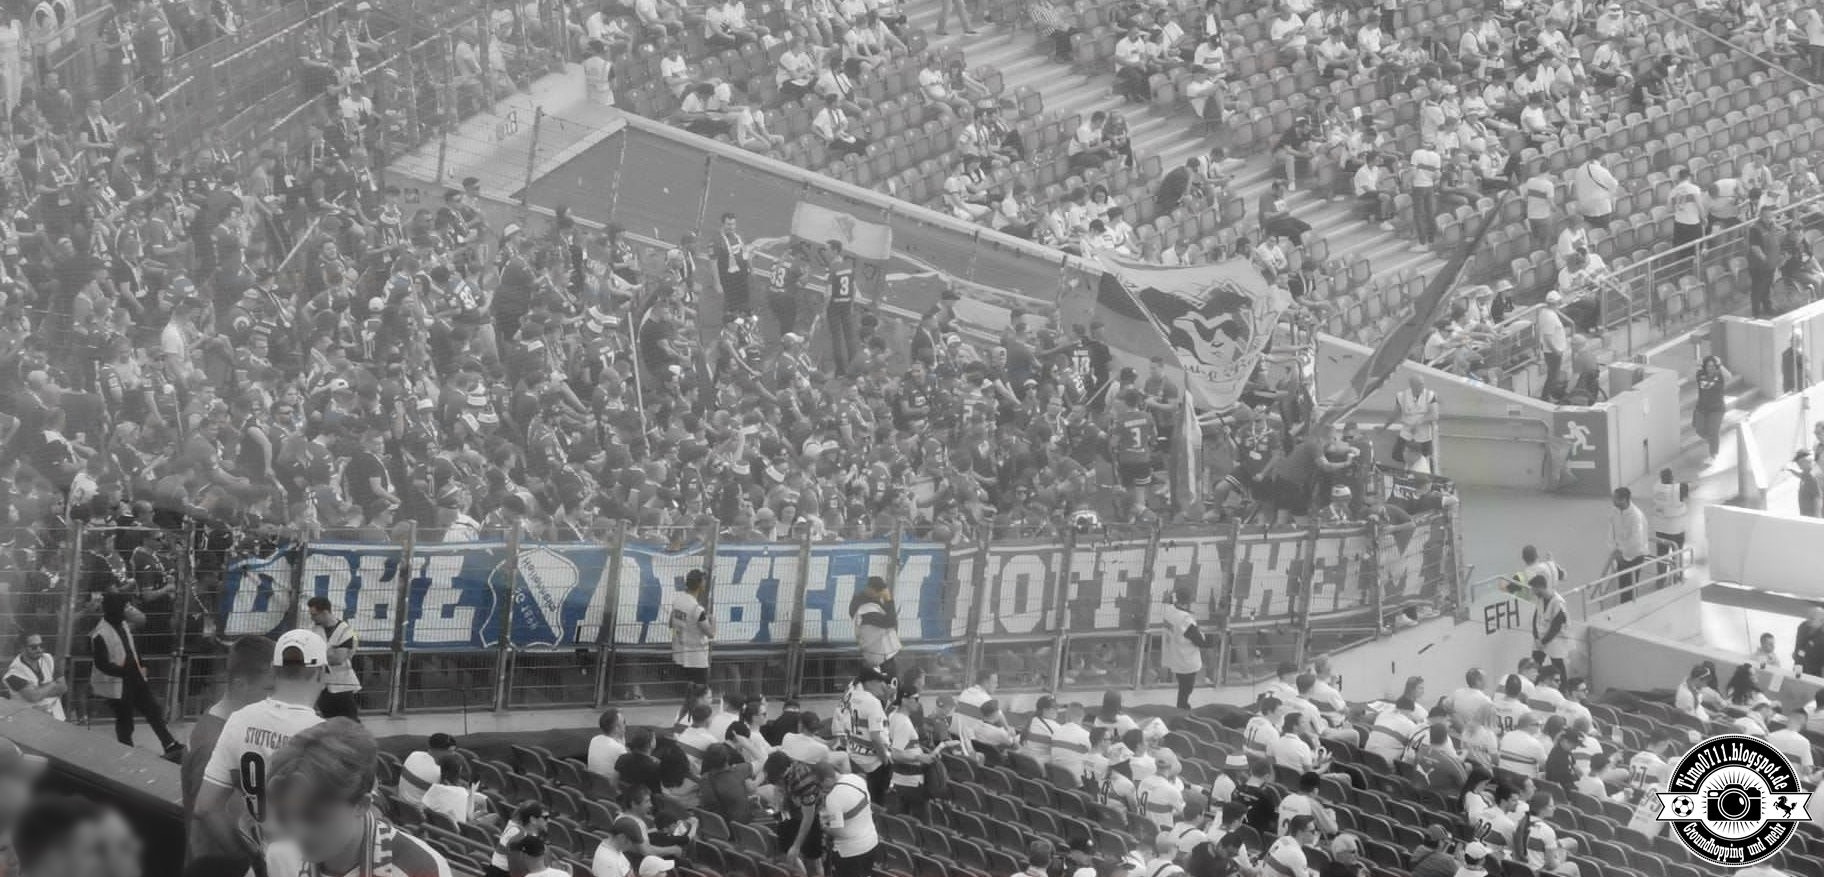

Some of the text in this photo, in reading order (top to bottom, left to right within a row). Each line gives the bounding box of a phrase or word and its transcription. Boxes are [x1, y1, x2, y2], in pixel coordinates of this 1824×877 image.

[839, 276, 849, 296] 3
[1484, 599, 1520, 635] EFH
[240, 751, 267, 824] 9
